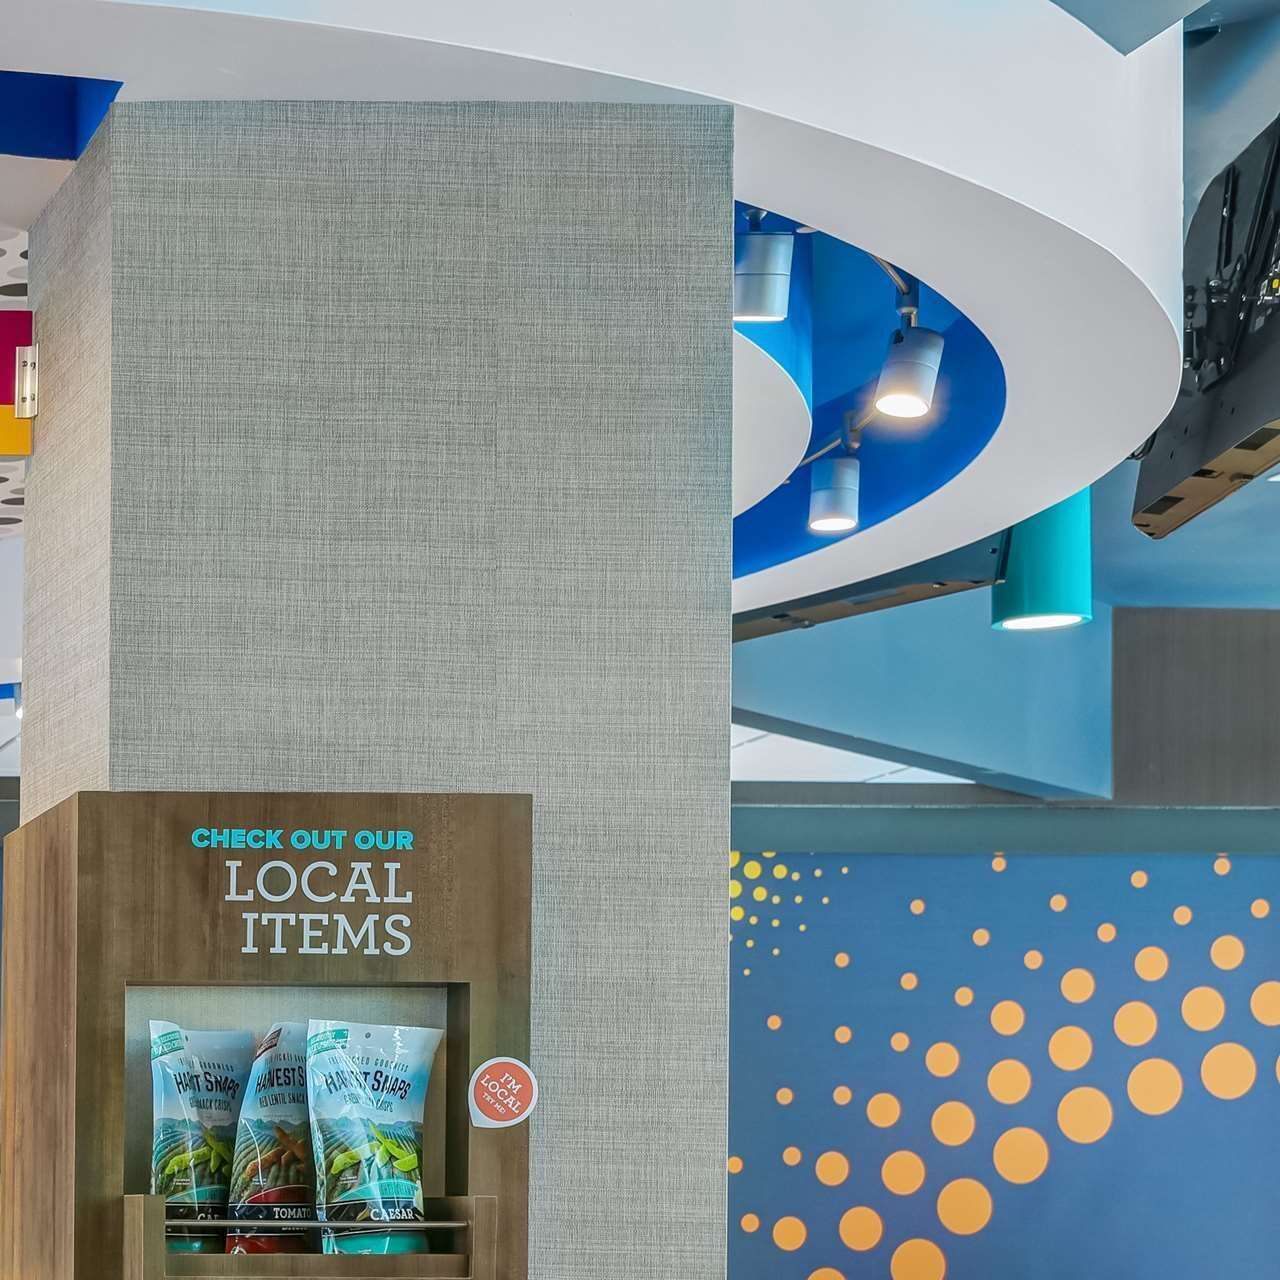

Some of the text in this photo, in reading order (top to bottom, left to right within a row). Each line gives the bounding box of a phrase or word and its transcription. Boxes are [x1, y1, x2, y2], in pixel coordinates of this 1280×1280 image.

[191, 828, 413, 850] CHECK OUT OUR
[225, 860, 412, 903] LOCAL
[242, 912, 411, 955] ITEMS
[480, 1074, 521, 1114] LOCAL
[500, 1073, 522, 1094] I'M
[370, 1209, 414, 1221] CAESAR
